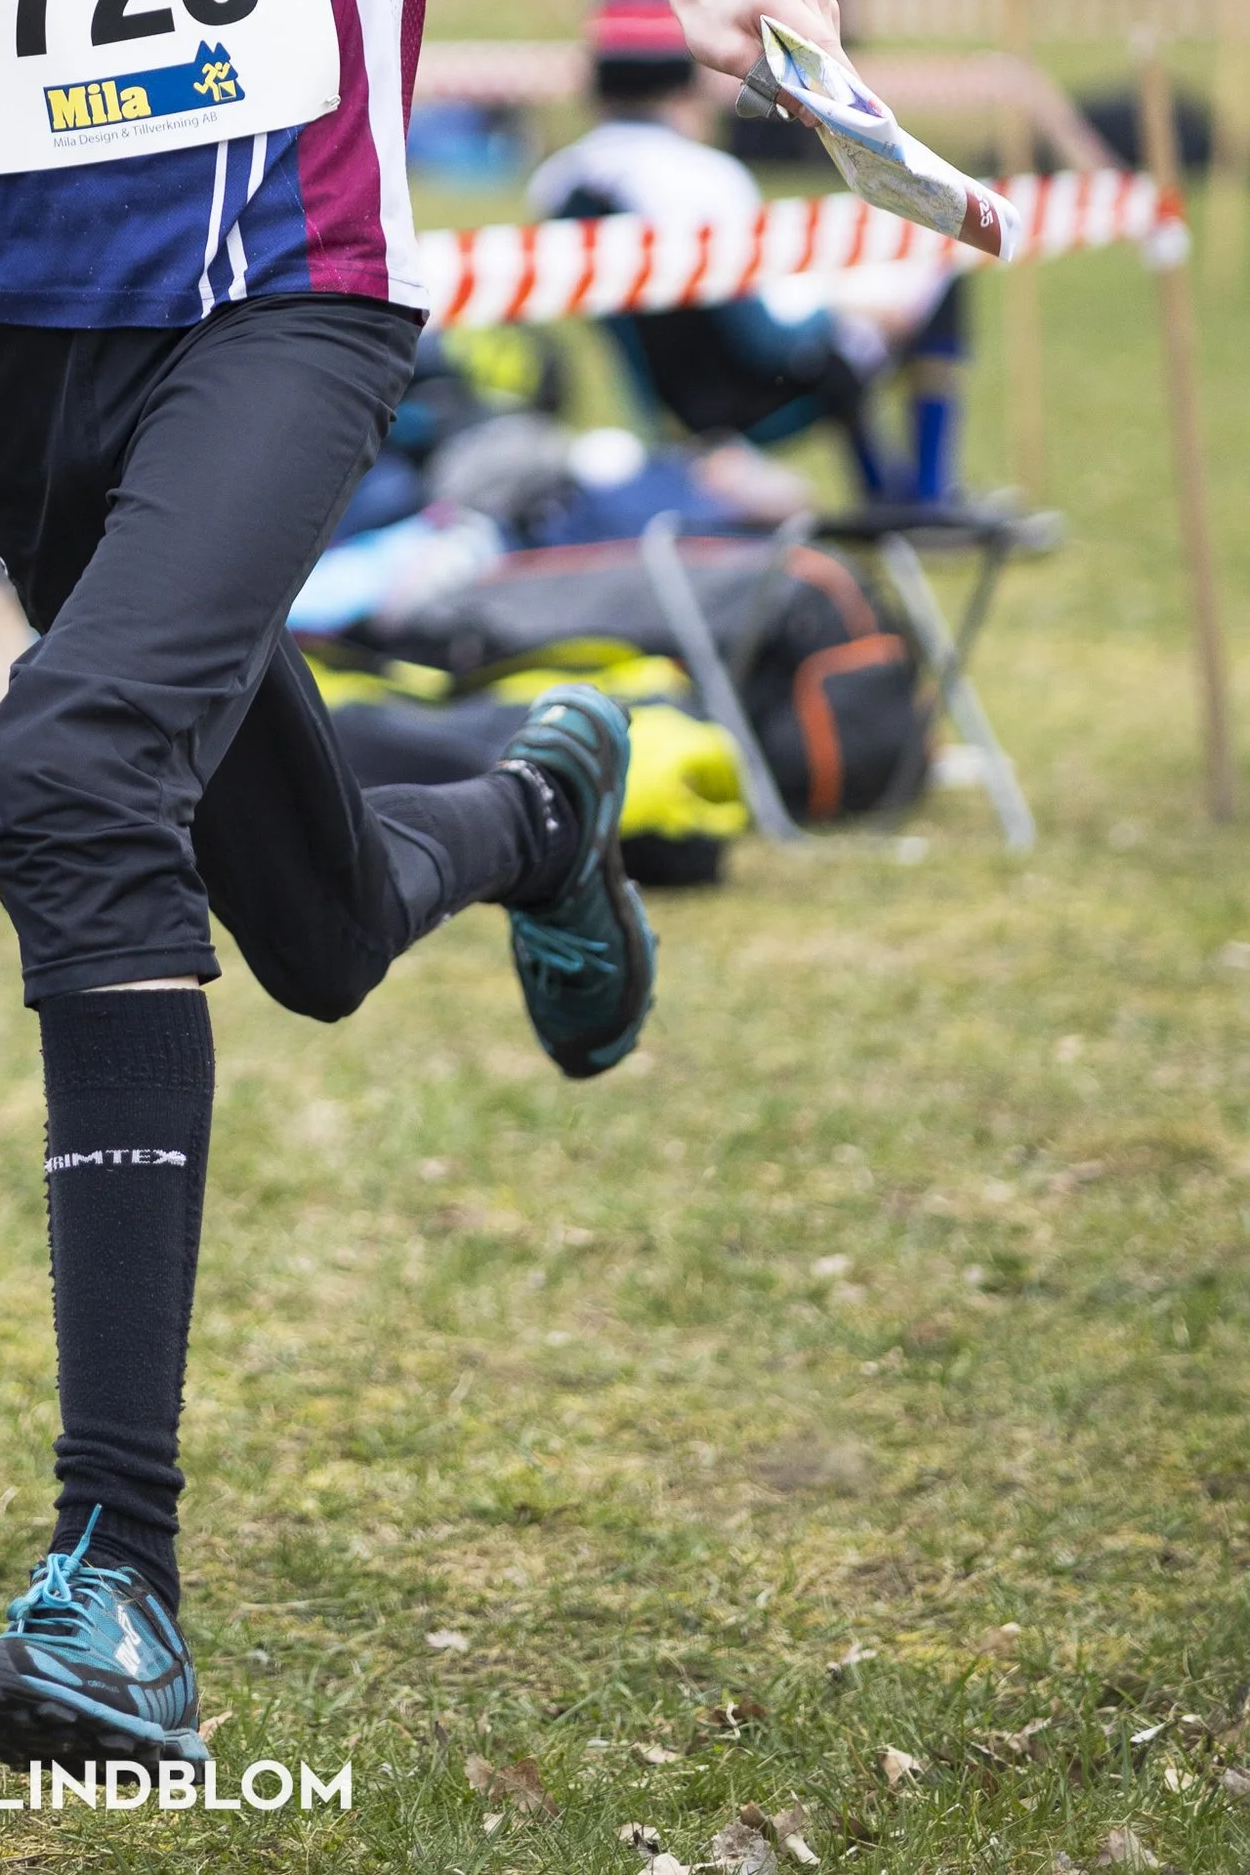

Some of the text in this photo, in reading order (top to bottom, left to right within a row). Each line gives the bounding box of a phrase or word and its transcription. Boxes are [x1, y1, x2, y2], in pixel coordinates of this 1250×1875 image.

[47, 80, 152, 130] Mila
[53, 111, 218, 148] Mila Design & Tillverkning AB
